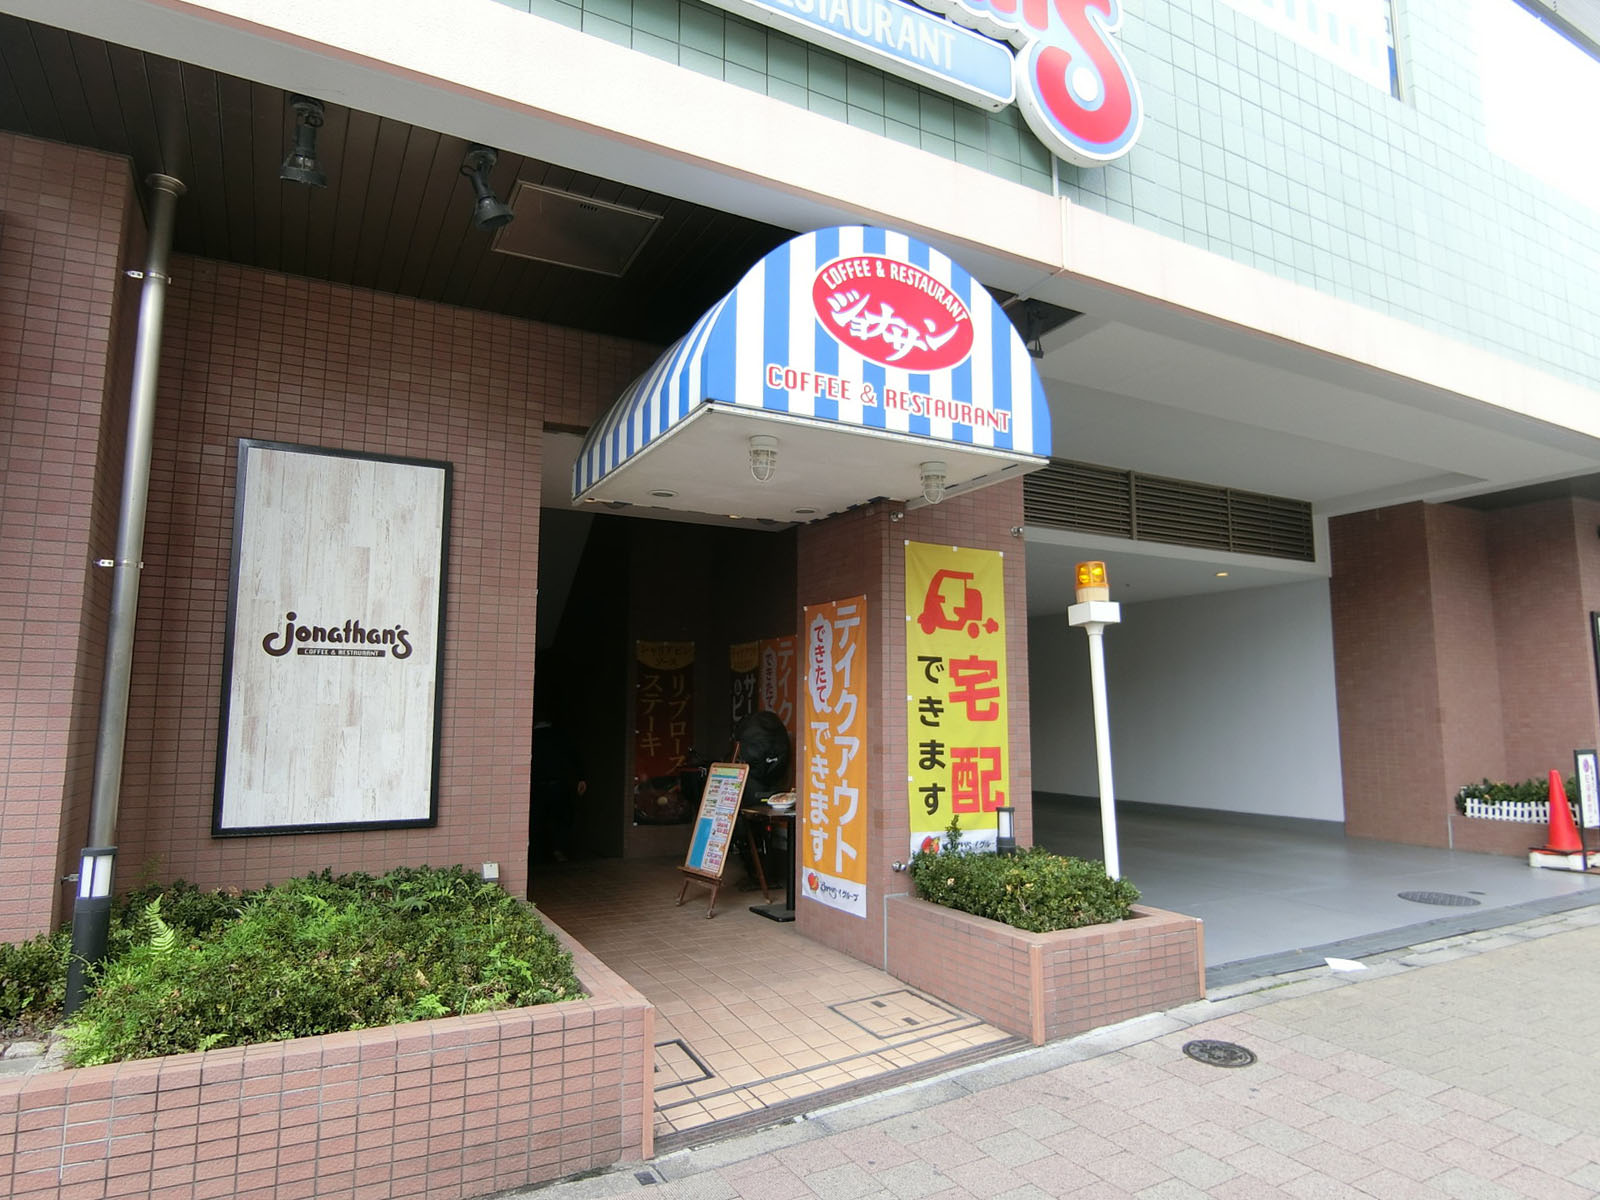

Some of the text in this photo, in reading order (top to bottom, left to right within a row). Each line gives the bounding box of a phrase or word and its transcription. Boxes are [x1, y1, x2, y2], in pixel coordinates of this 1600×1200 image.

[822, 259, 969, 323] COFFEE & RESTAURANT
[826, 289, 959, 362] ジョナサン
[767, 365, 1011, 431] COFFEE & RESTAURANT
[338, 649, 380, 657] RESTAURANT
[744, 673, 757, 714] サー
[777, 640, 795, 732] テイク
[813, 624, 829, 704] できたて
[640, 673, 663, 758] ステーキ
[833, 605, 861, 873] テイクアウト
[917, 655, 947, 816] できます
[948, 655, 1005, 814] 宅配
[809, 721, 831, 863] できます
